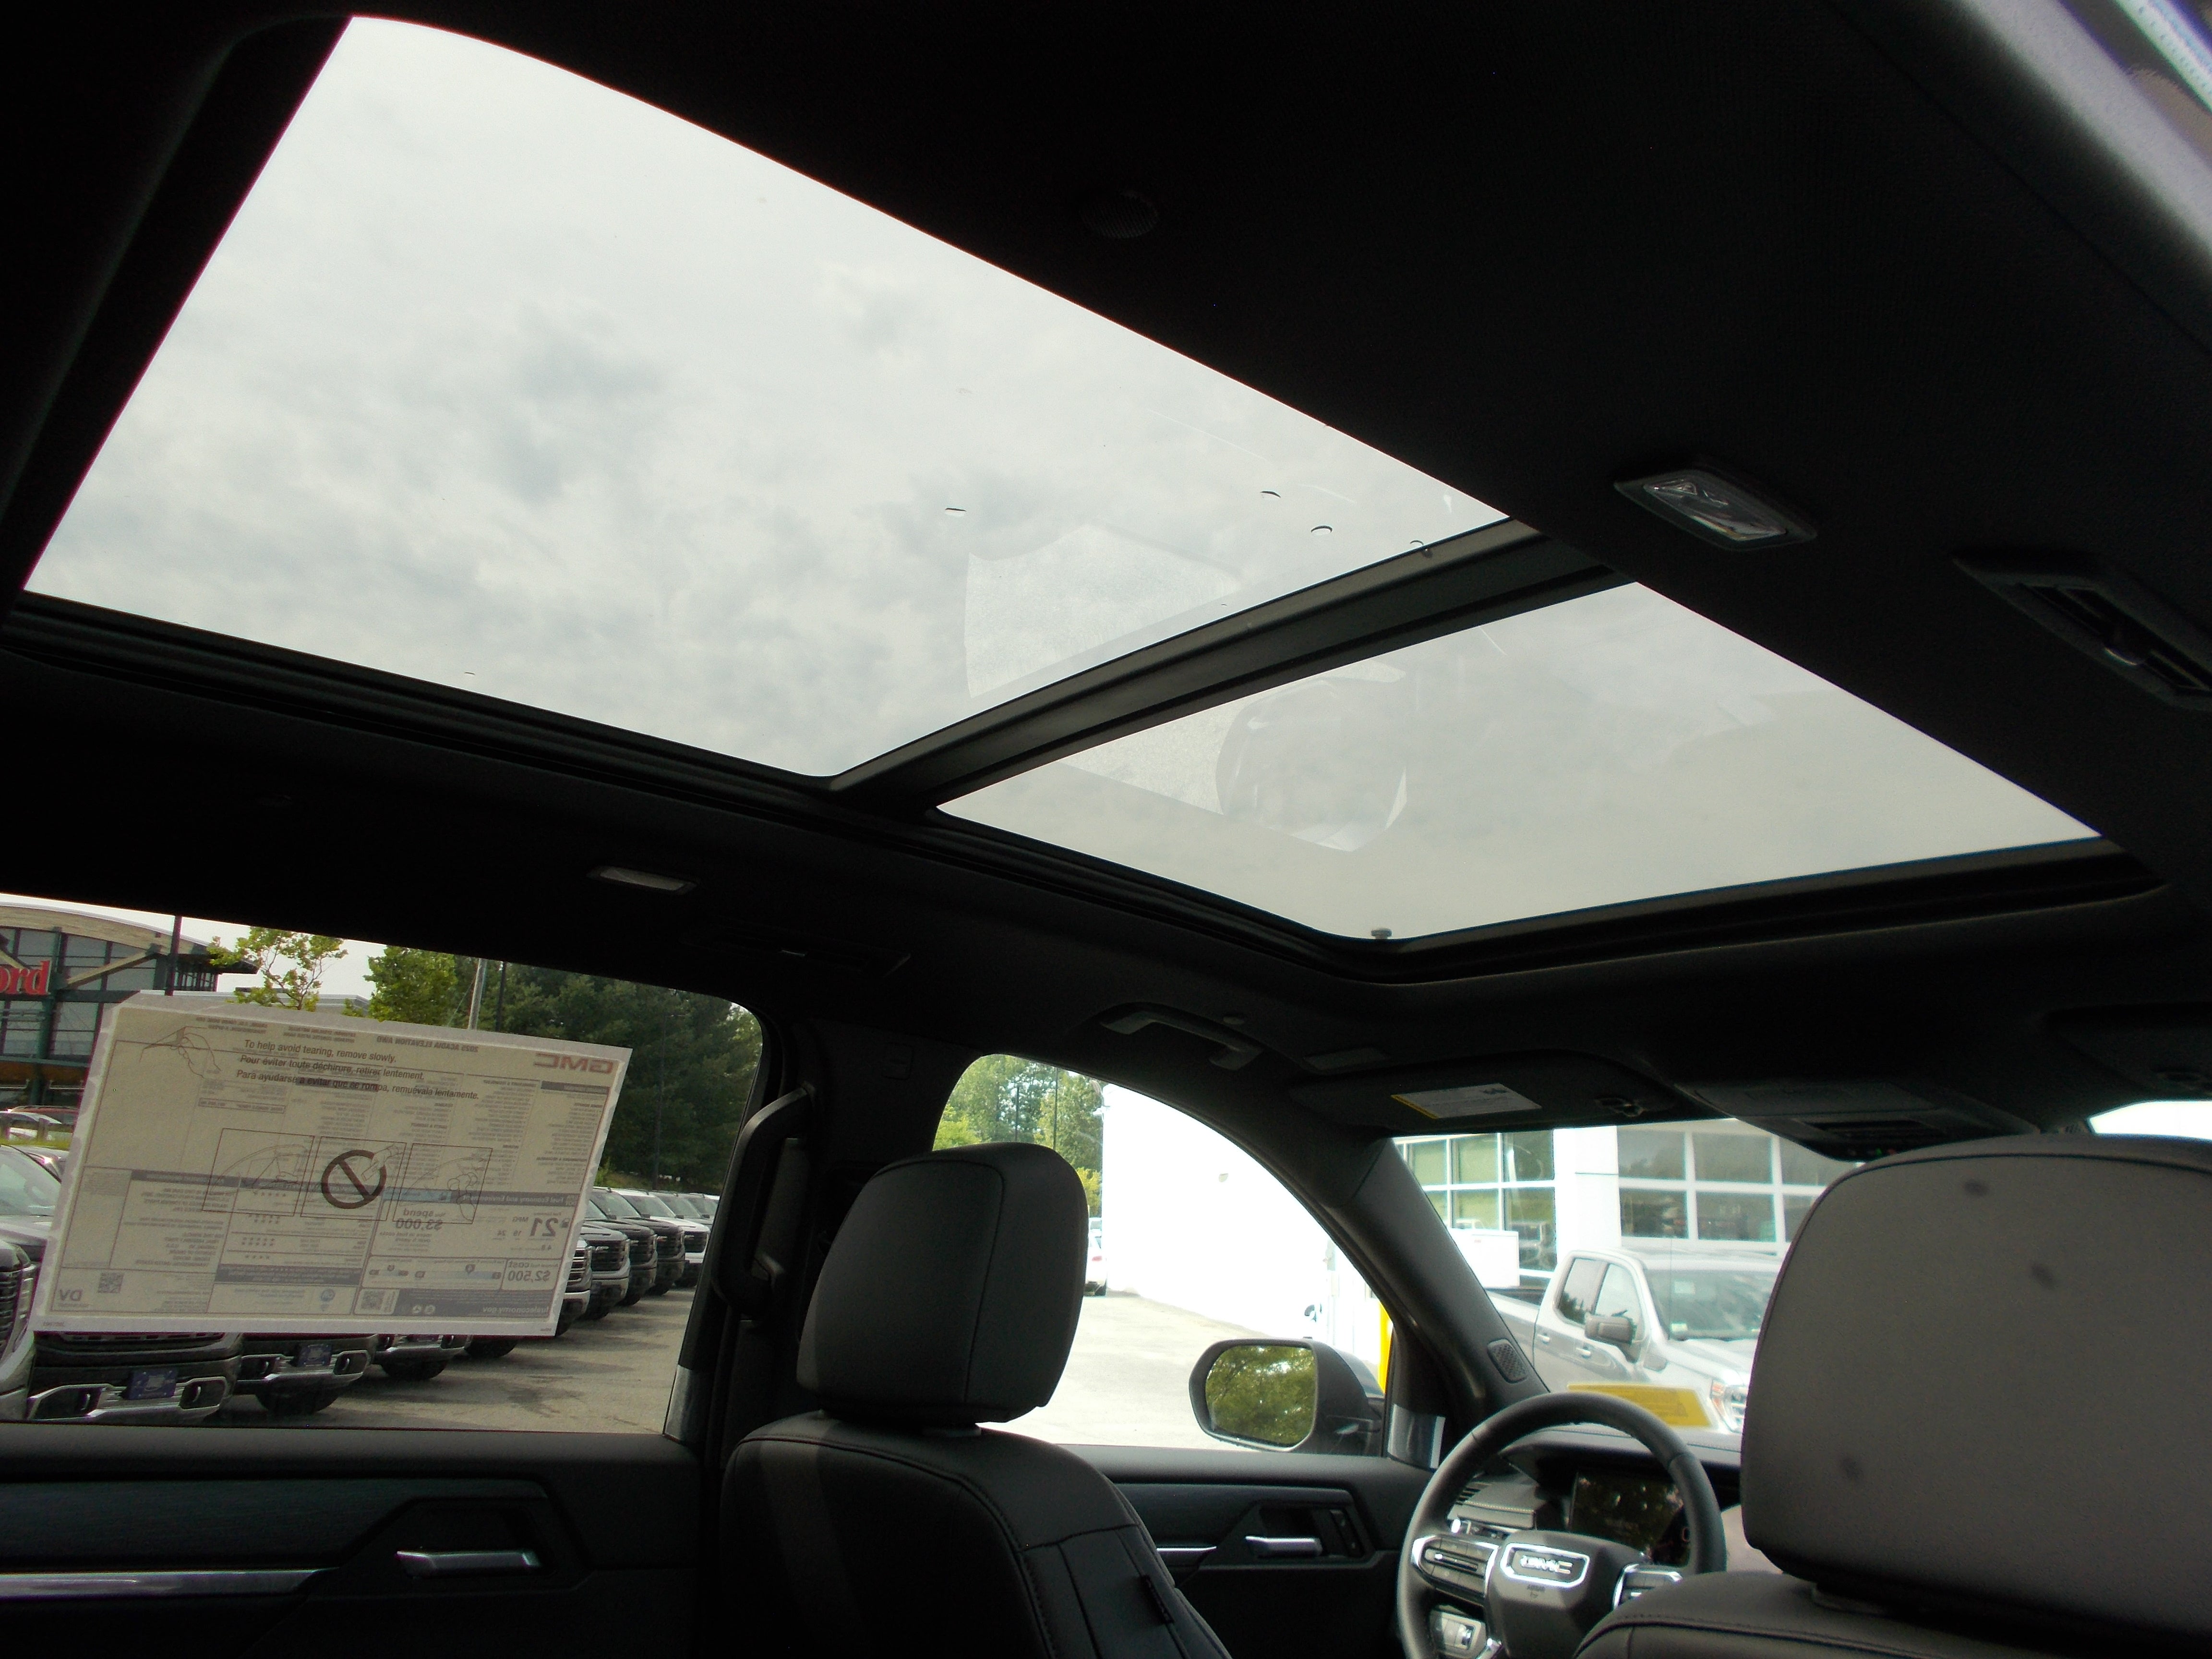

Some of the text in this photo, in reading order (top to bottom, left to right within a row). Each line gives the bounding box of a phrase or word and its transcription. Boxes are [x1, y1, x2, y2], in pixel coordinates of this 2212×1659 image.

[245, 1040, 397, 1063] To help avoid tearing, remove slowly.
[240, 1055, 424, 1080] Pour éviter toute déchirure, retirer lentement.
[236, 1069, 256, 1080] Para
[258, 1072, 297, 1084] ayudarse
[307, 1077, 330, 1086] evitar
[333, 1080, 348, 1091] que
[361, 1083, 389, 1093] rompa,
[392, 1085, 433, 1096] remuévala
[434, 1088, 479, 1100] lentamente.
[1520, 1556, 1573, 1575] GMC
